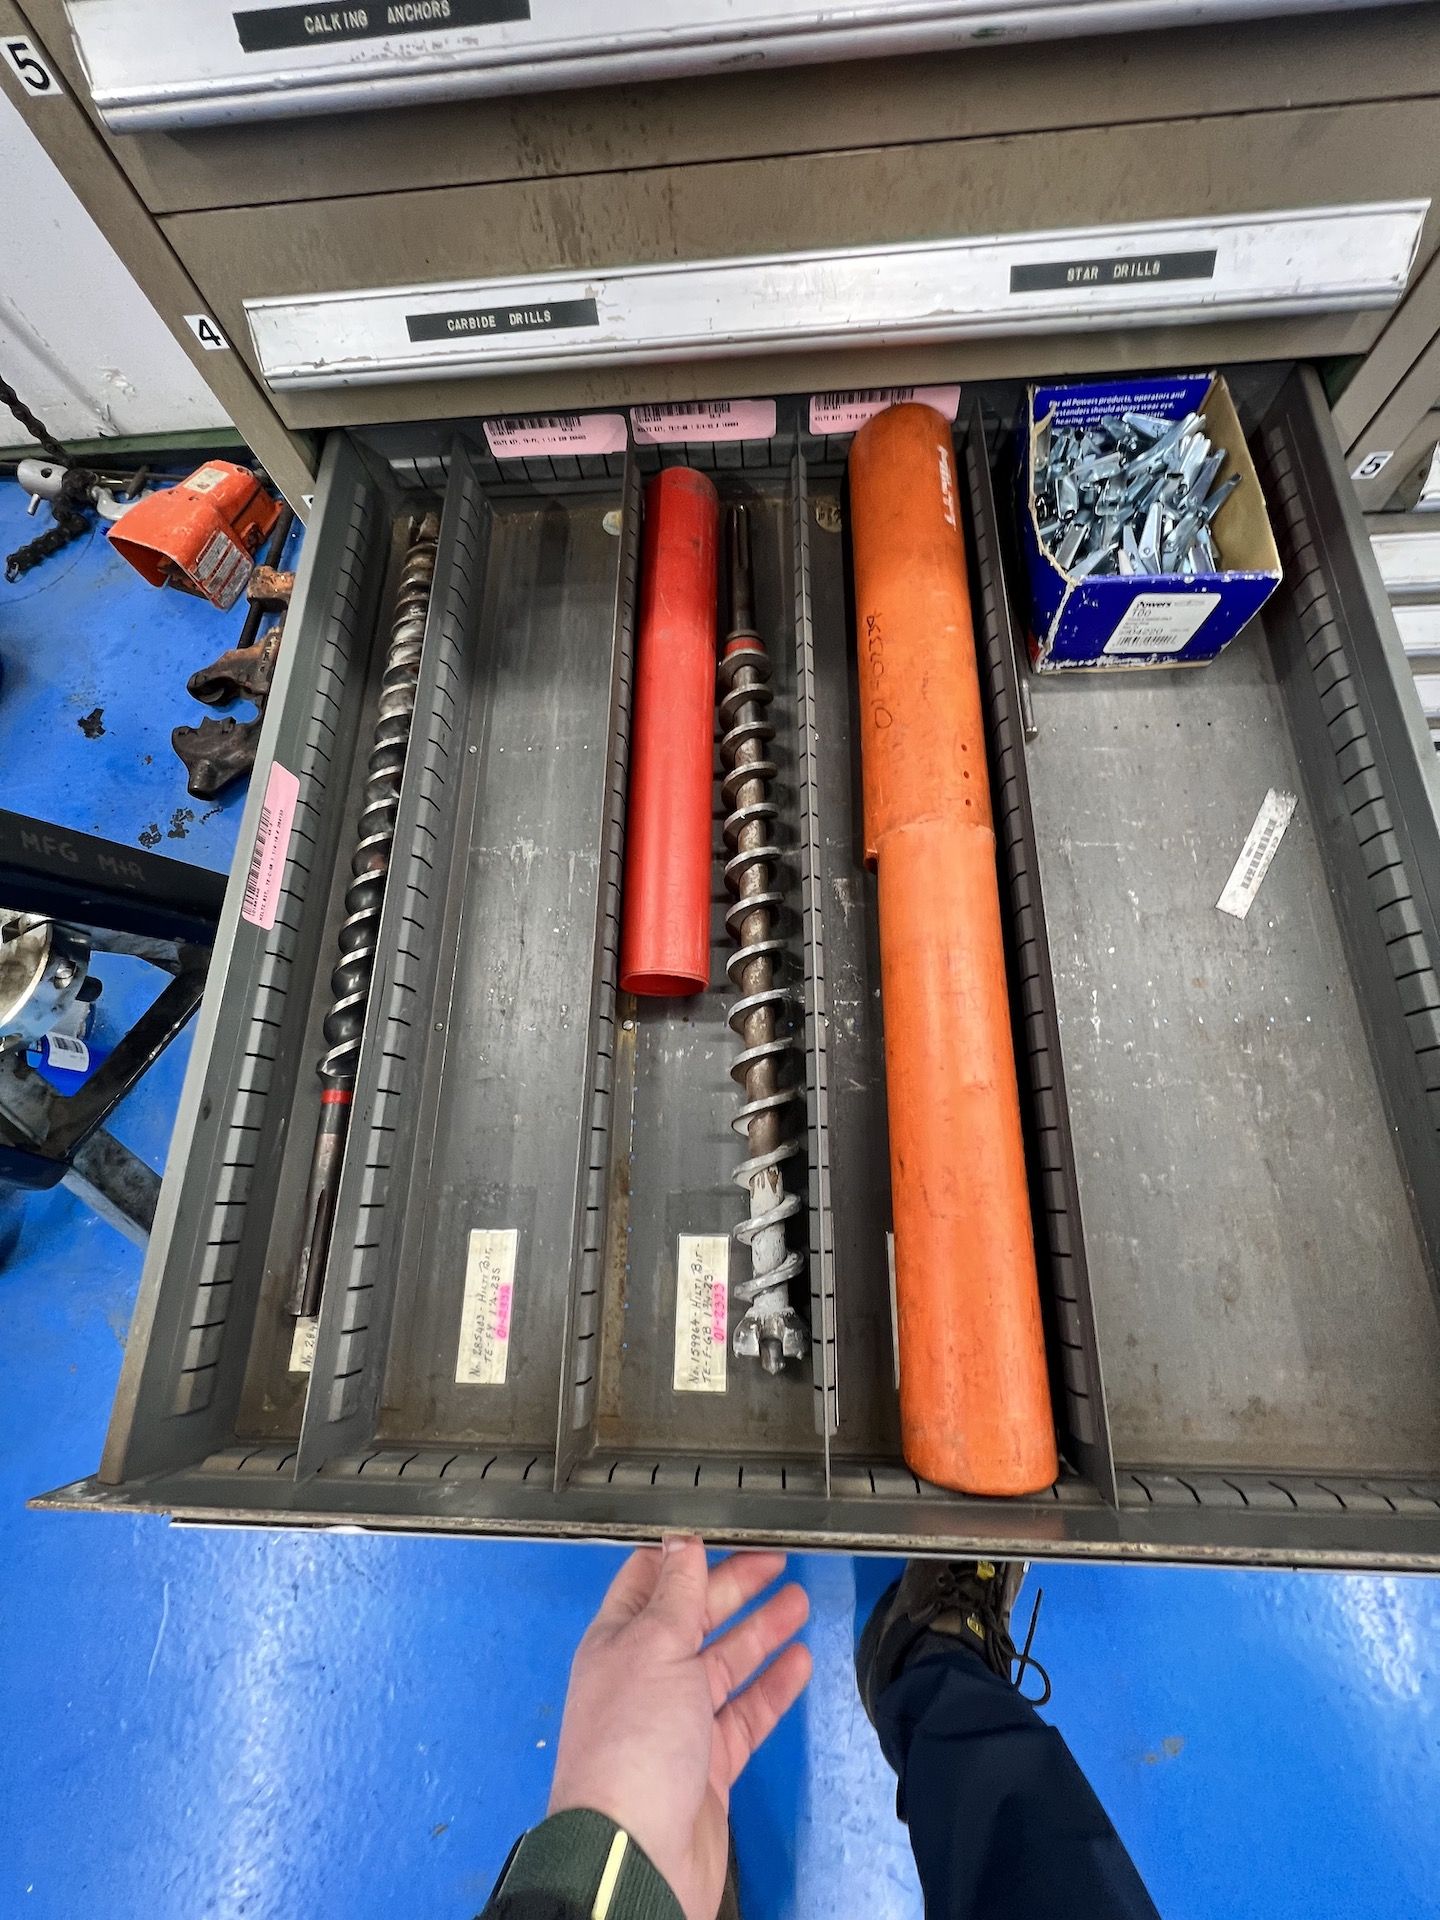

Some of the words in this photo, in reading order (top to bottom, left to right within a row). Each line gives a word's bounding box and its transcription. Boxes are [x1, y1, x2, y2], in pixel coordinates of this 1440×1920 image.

[304, 10, 368, 35] CALKING
[387, 0, 451, 22] ANCHORS
[12, 42, 51, 90] 5
[1066, 264, 1099, 281] STAR
[1113, 261, 1160, 279] DRILLS
[447, 313, 497, 331] CARBIDE
[508, 309, 552, 326] DRILLS
[197, 317, 223, 346] 4
[1062, 398, 1071, 406] all
[1072, 397, 1098, 406] Powers
[1098, 395, 1132, 405] products,
[1134, 393, 1169, 402] operators
[1171, 390, 1186, 399] and
[1091, 404, 1115, 415] should
[1115, 403, 1140, 413] always
[1141, 402, 1159, 410] wear
[1360, 456, 1388, 475] 5
[1132, 609, 1151, 617] 100
[20, 830, 79, 863] MFG
[690, 1278, 702, 1309] HILTI
